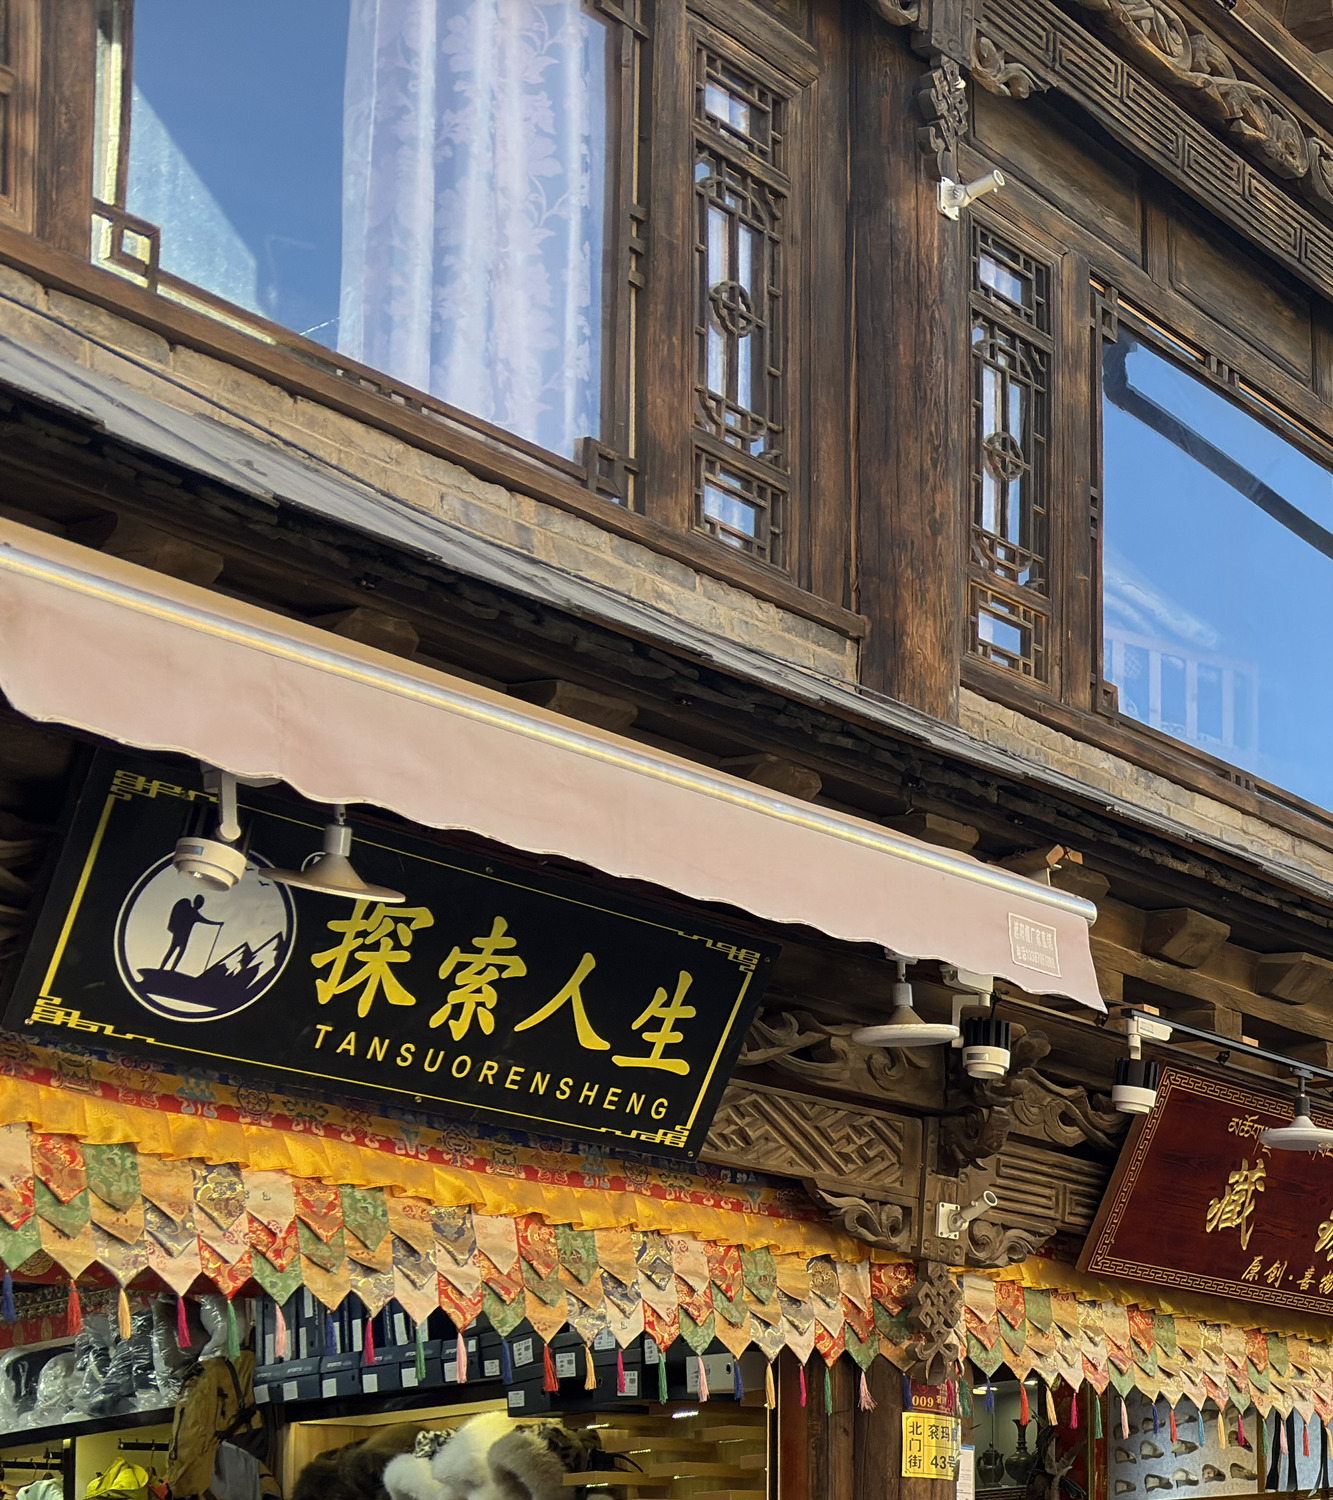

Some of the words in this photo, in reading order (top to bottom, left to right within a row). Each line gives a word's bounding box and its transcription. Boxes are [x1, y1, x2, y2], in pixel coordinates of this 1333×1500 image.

[310, 900, 698, 1076] 探索人生
[313, 1023, 670, 1121] TANSUORENSHENG
[908, 1421, 923, 1469] 北门街
[930, 1454, 956, 1469] 43号
